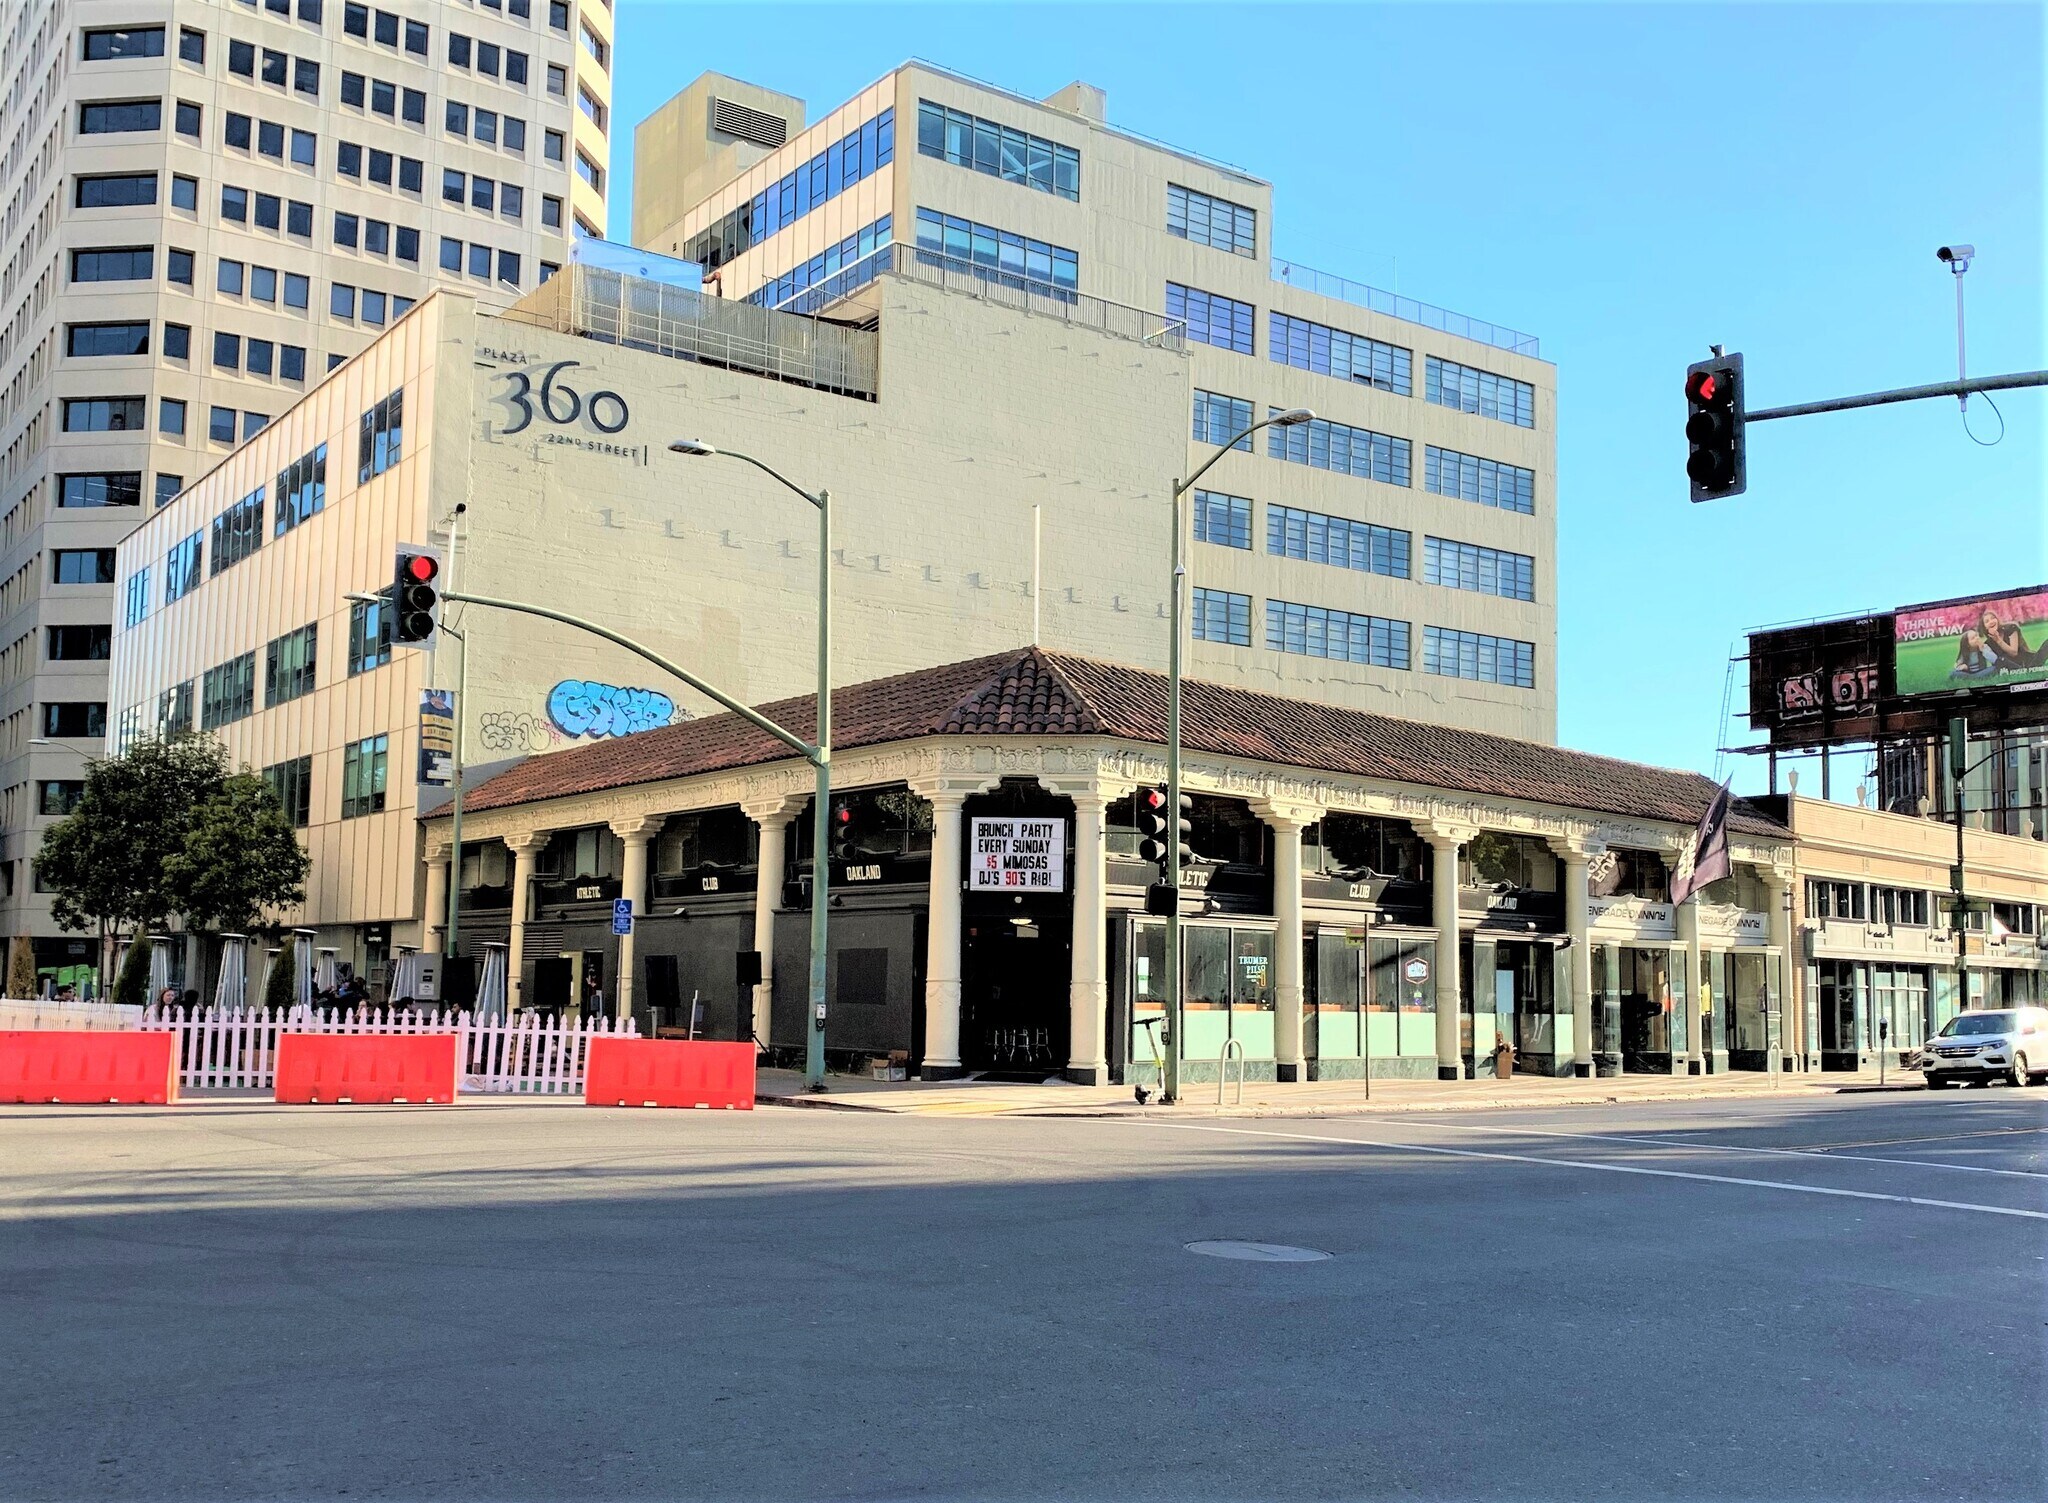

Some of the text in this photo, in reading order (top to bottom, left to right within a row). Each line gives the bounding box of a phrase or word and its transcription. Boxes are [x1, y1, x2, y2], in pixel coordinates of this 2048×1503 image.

[483, 347, 528, 365] PLAZA
[501, 360, 629, 435] 360
[587, 440, 638, 458] STREET
[1902, 617, 1945, 630] THRIVE
[1902, 623, 1966, 642] YOUR WAY
[978, 823, 1053, 838] BRUNCH PARTY
[978, 839, 1051, 853] EVERY SUNDAY
[987, 855, 1048, 870] $5 MIMOSAS
[846, 864, 882, 881] OAKLAND
[979, 871, 1000, 885] DJ'S
[1005, 871, 1026, 886] 90'S
[702, 876, 719, 891] CLUB
[576, 885, 601, 899] ATHLETIC
[1349, 884, 1371, 899] CLUB
[1486, 895, 1518, 910] OAKLAND
[1588, 905, 1629, 918] ENEGADE
[1238, 956, 1269, 965] TRUMER
